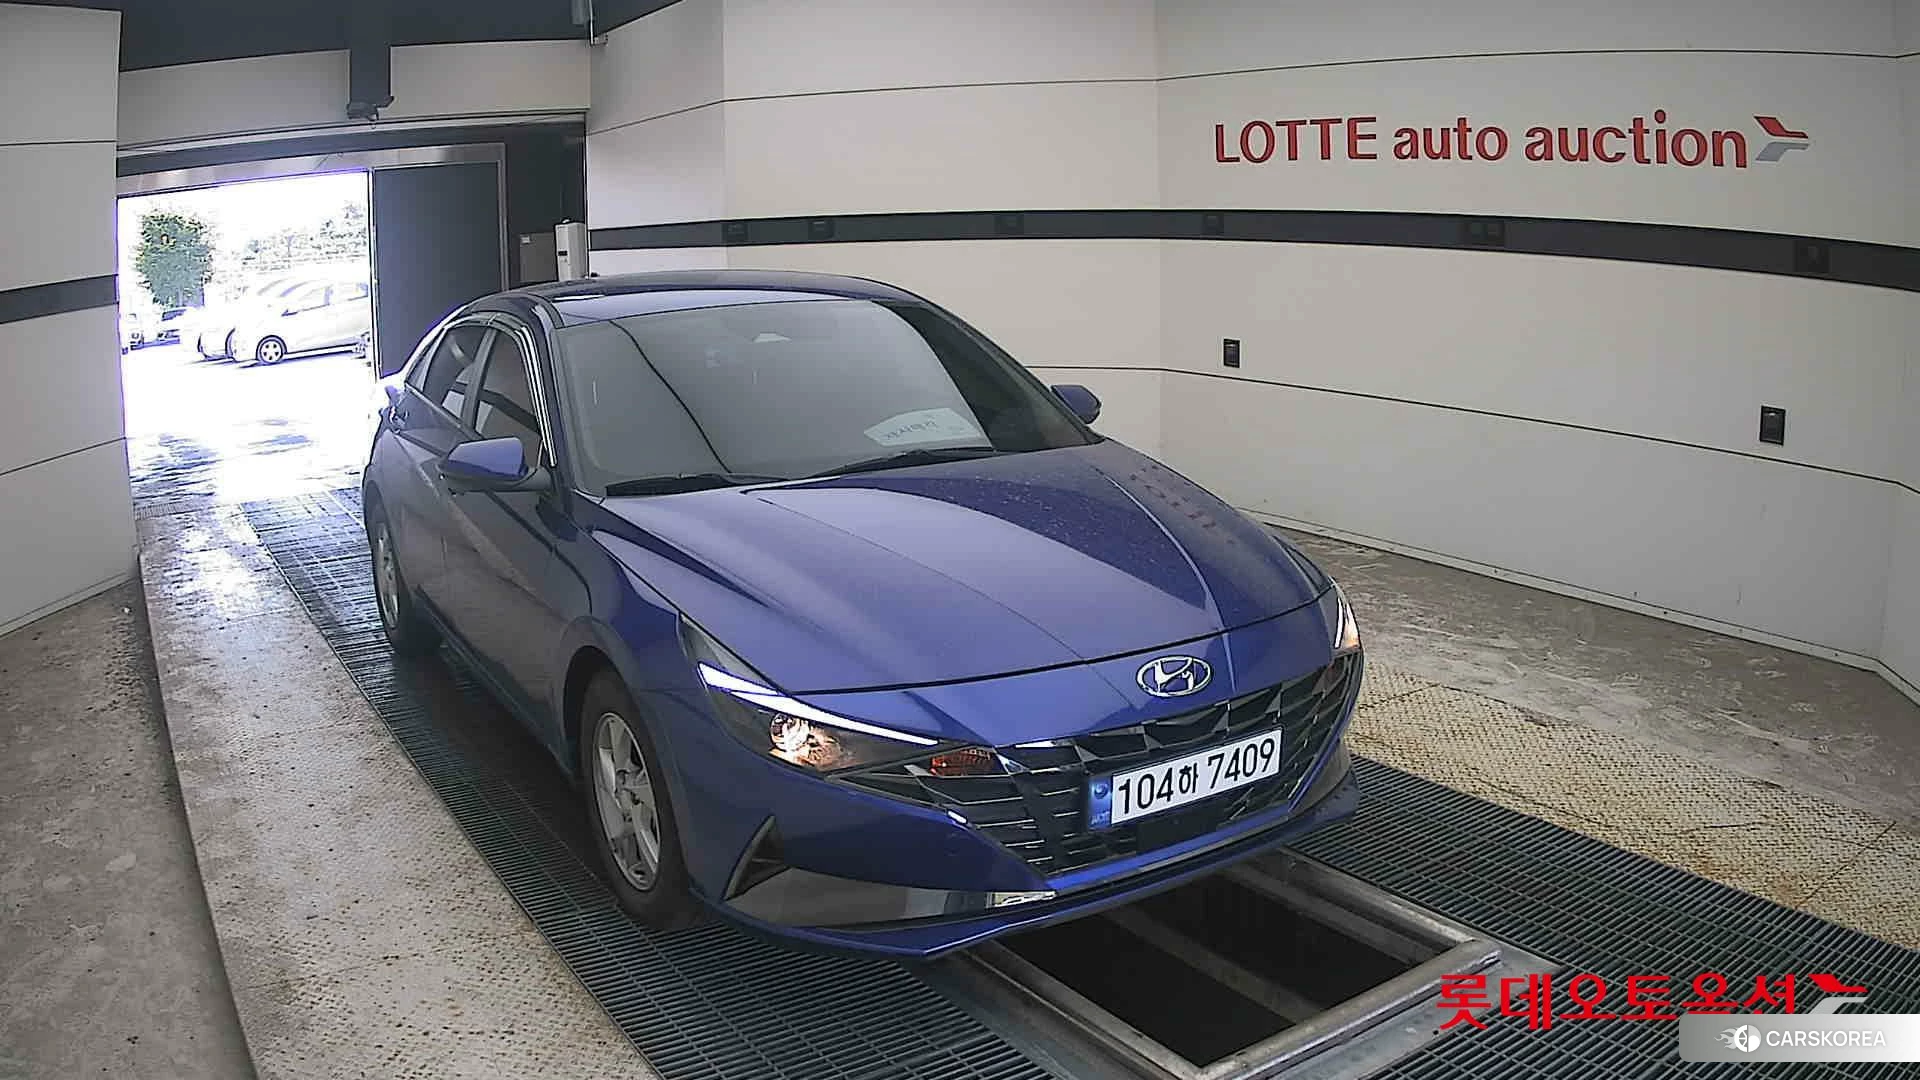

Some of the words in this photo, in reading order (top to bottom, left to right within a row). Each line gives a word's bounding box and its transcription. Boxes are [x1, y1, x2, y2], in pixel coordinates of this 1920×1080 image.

[1215, 117, 1377, 163] LOTTE
[1392, 117, 1509, 162] auto
[1524, 110, 1748, 168] auction
[1118, 762, 1199, 815] 104하
[1207, 738, 1276, 789] 7409
